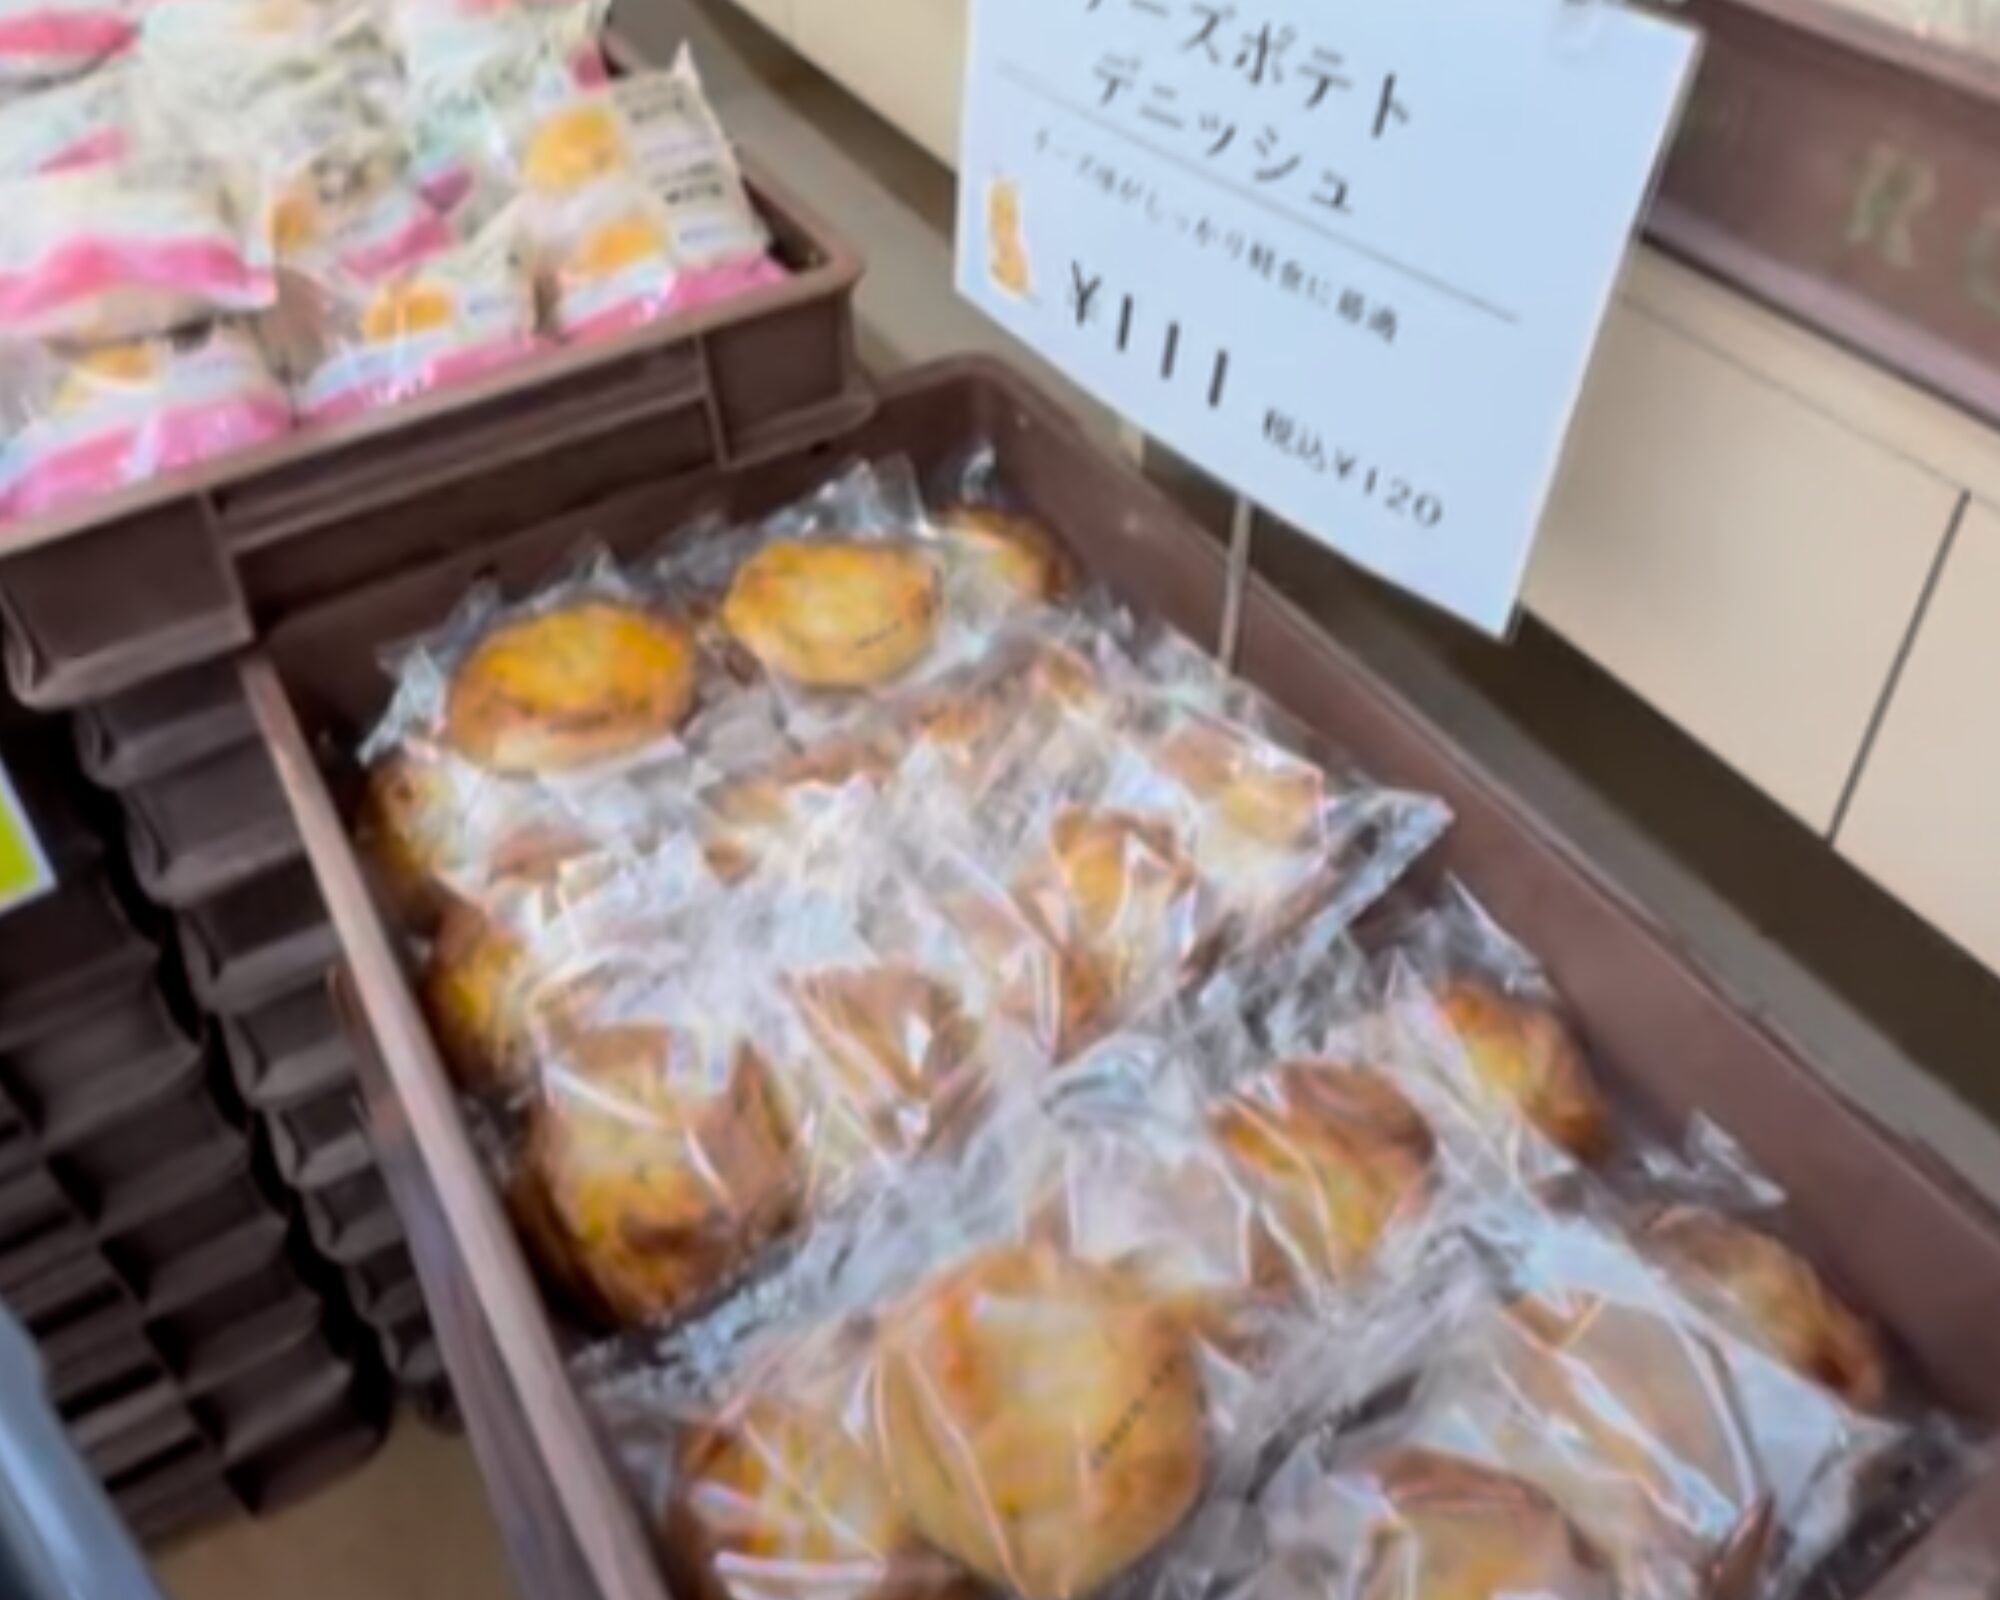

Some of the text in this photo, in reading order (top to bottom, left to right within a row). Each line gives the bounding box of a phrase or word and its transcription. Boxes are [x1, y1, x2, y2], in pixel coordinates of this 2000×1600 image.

[1086, 0, 1409, 138] ーズポテト
[1092, 53, 1352, 213] デニッシュ
